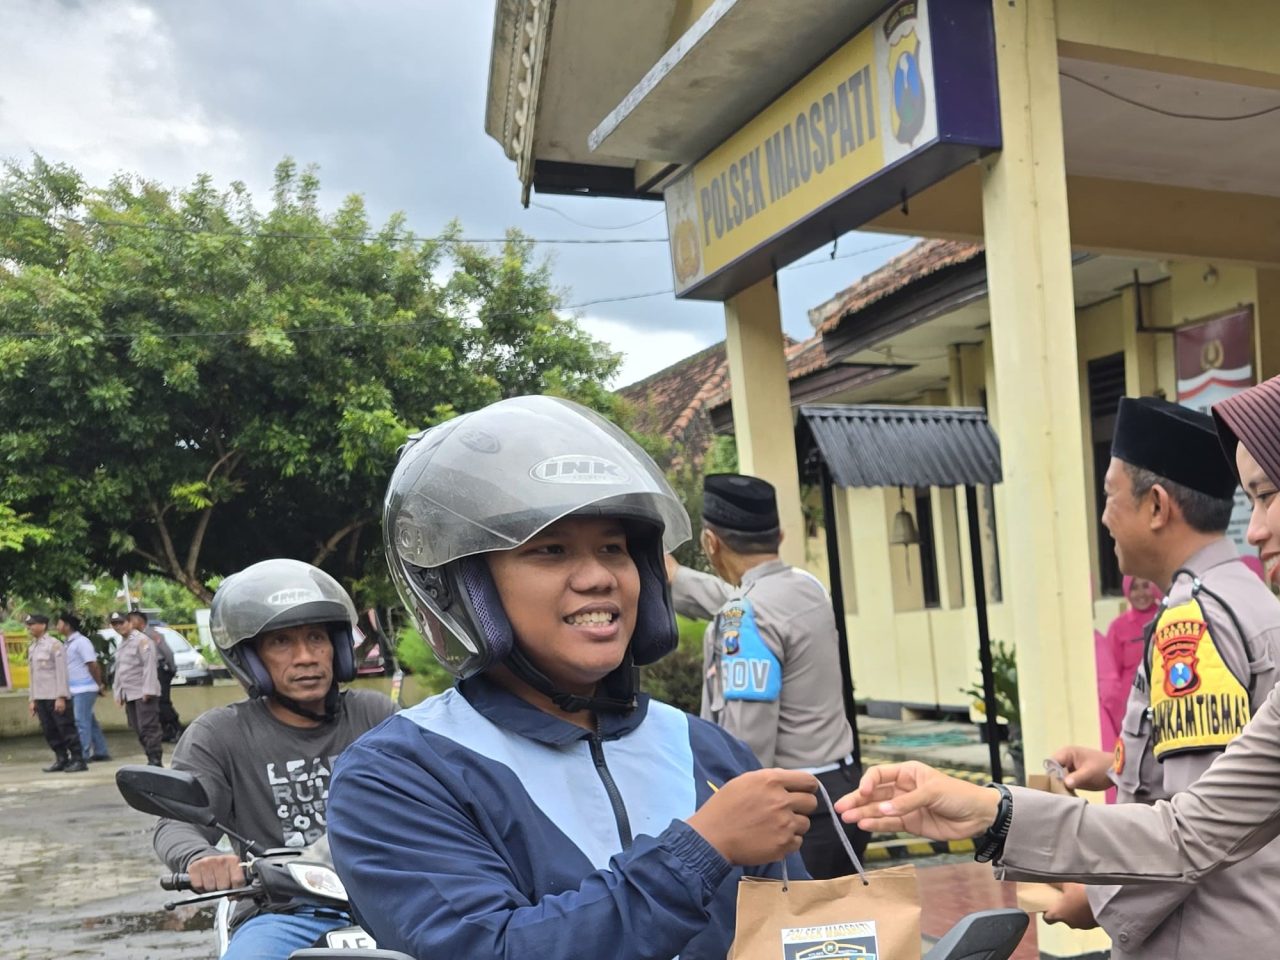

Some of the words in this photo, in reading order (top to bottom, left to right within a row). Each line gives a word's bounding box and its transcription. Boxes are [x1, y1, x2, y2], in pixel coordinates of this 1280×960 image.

[700, 147, 767, 246] POLSEK
[765, 64, 877, 203] MAOSPATI
[544, 461, 620, 478] INK
[267, 757, 338, 785] LEA
